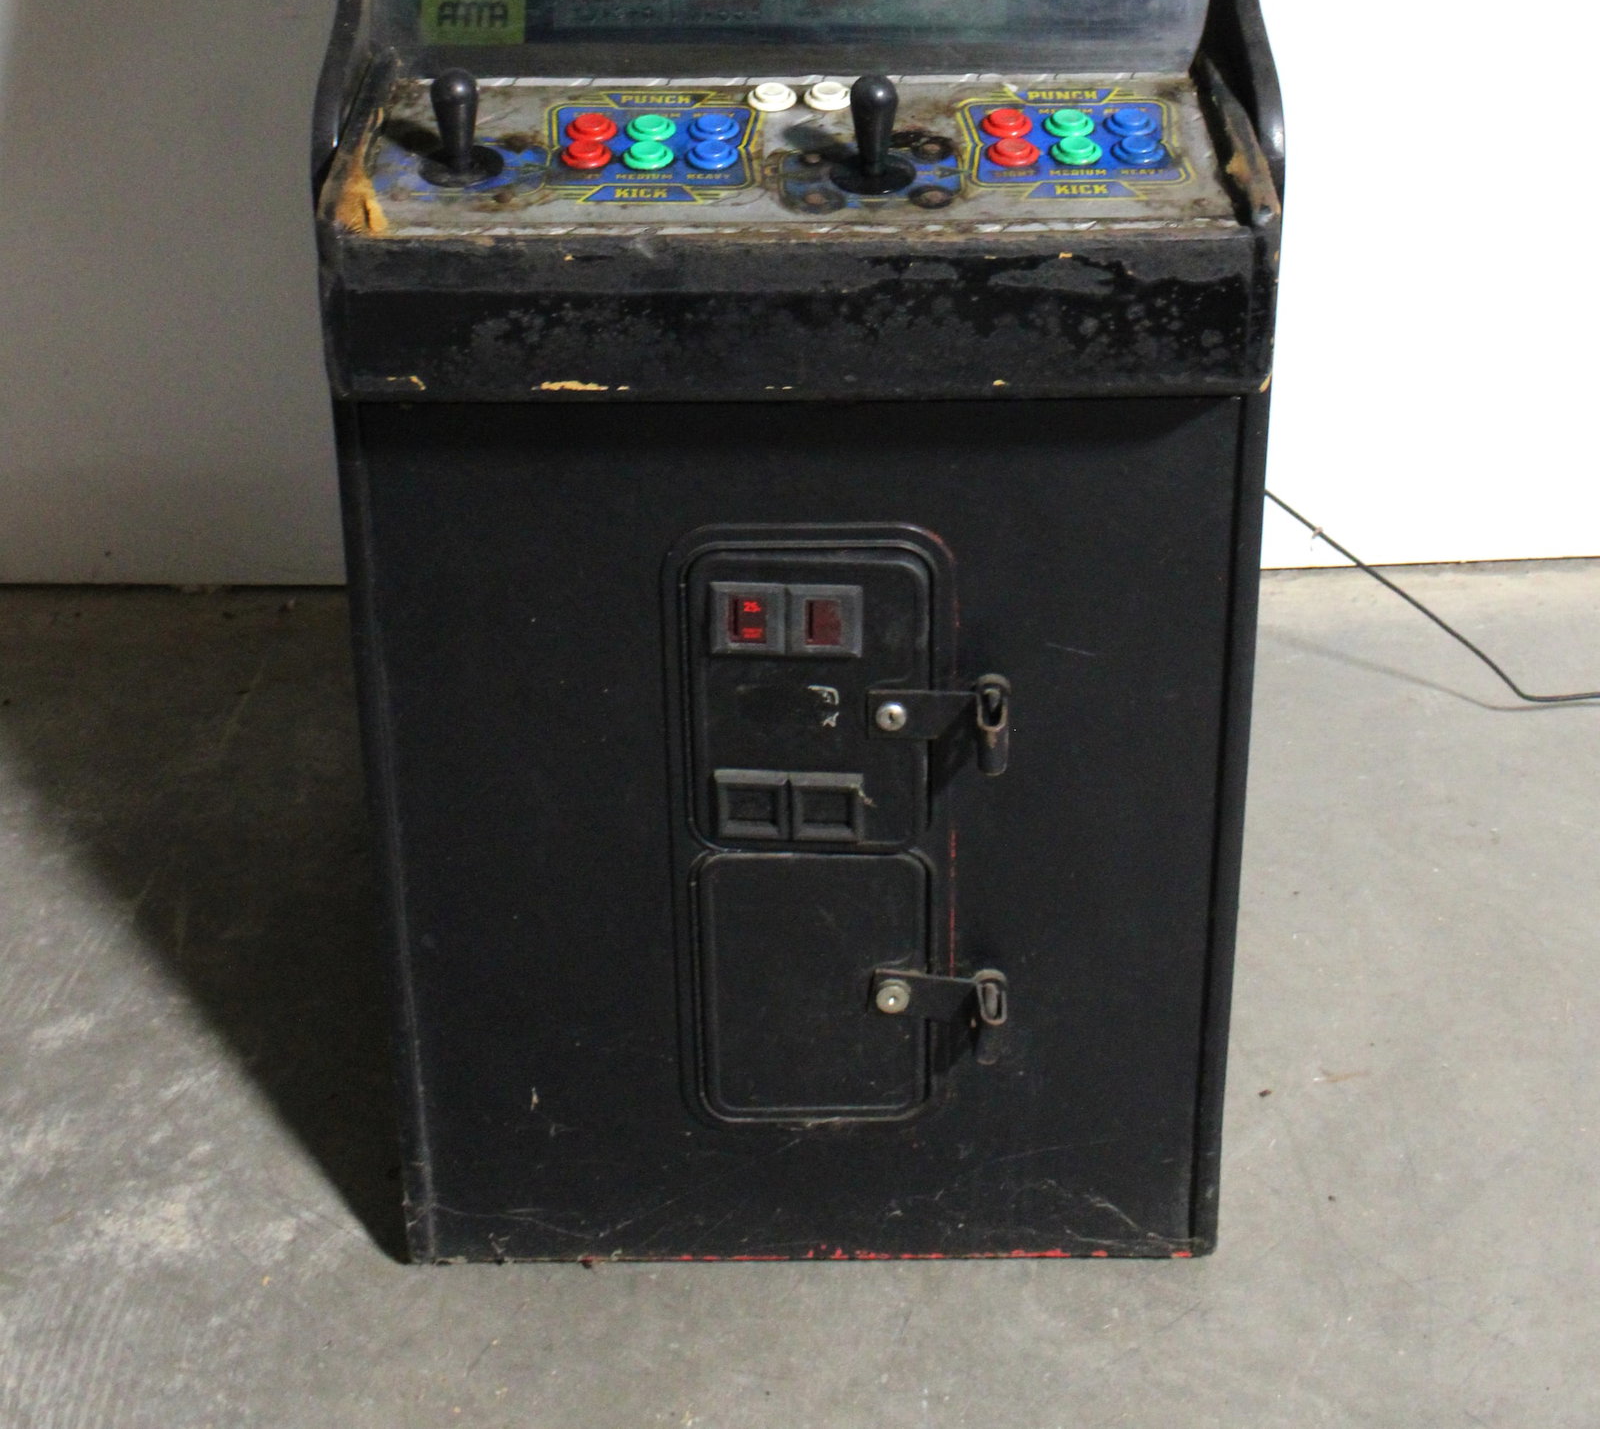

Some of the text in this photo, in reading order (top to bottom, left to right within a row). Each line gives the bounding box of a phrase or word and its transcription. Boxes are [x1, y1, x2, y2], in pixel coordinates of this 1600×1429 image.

[620, 95, 692, 105] PUNCH
[1027, 90, 1098, 100] PUNCH
[614, 188, 668, 199] KICK
[1054, 184, 1109, 195] KICK
